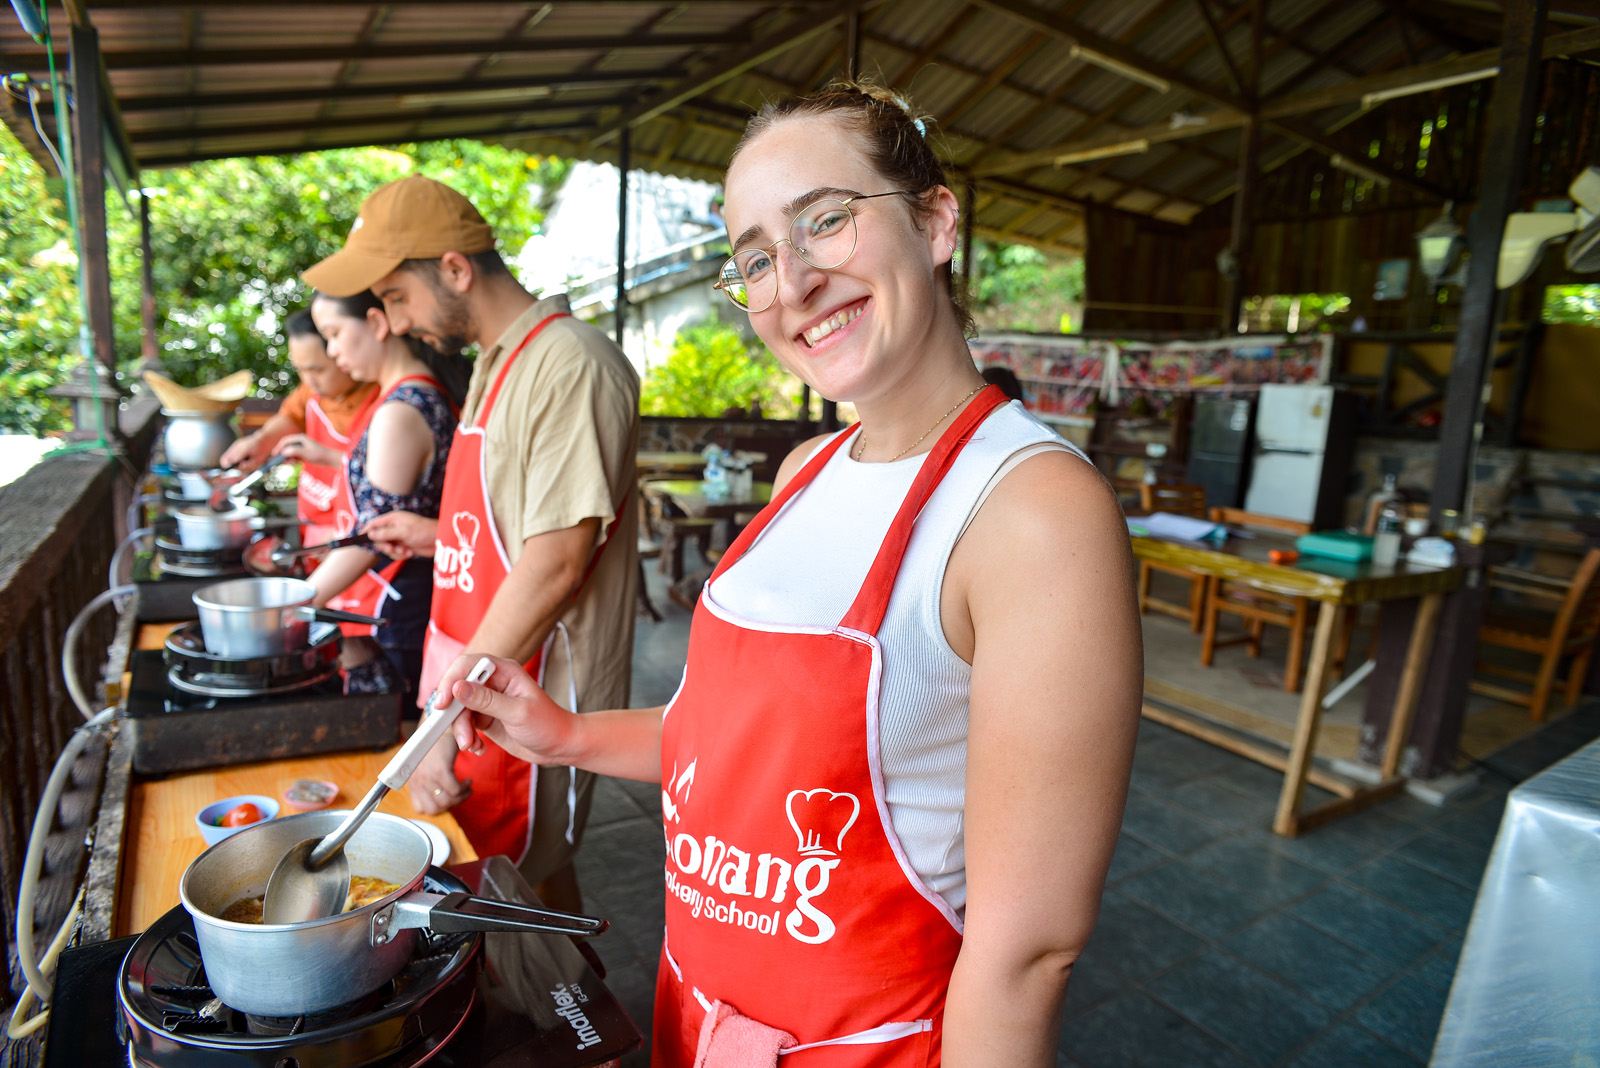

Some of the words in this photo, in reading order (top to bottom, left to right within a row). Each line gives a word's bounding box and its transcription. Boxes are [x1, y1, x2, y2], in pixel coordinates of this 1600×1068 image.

[664, 828, 841, 944] onang
[664, 868, 703, 918] okery
[704, 896, 780, 936] School
